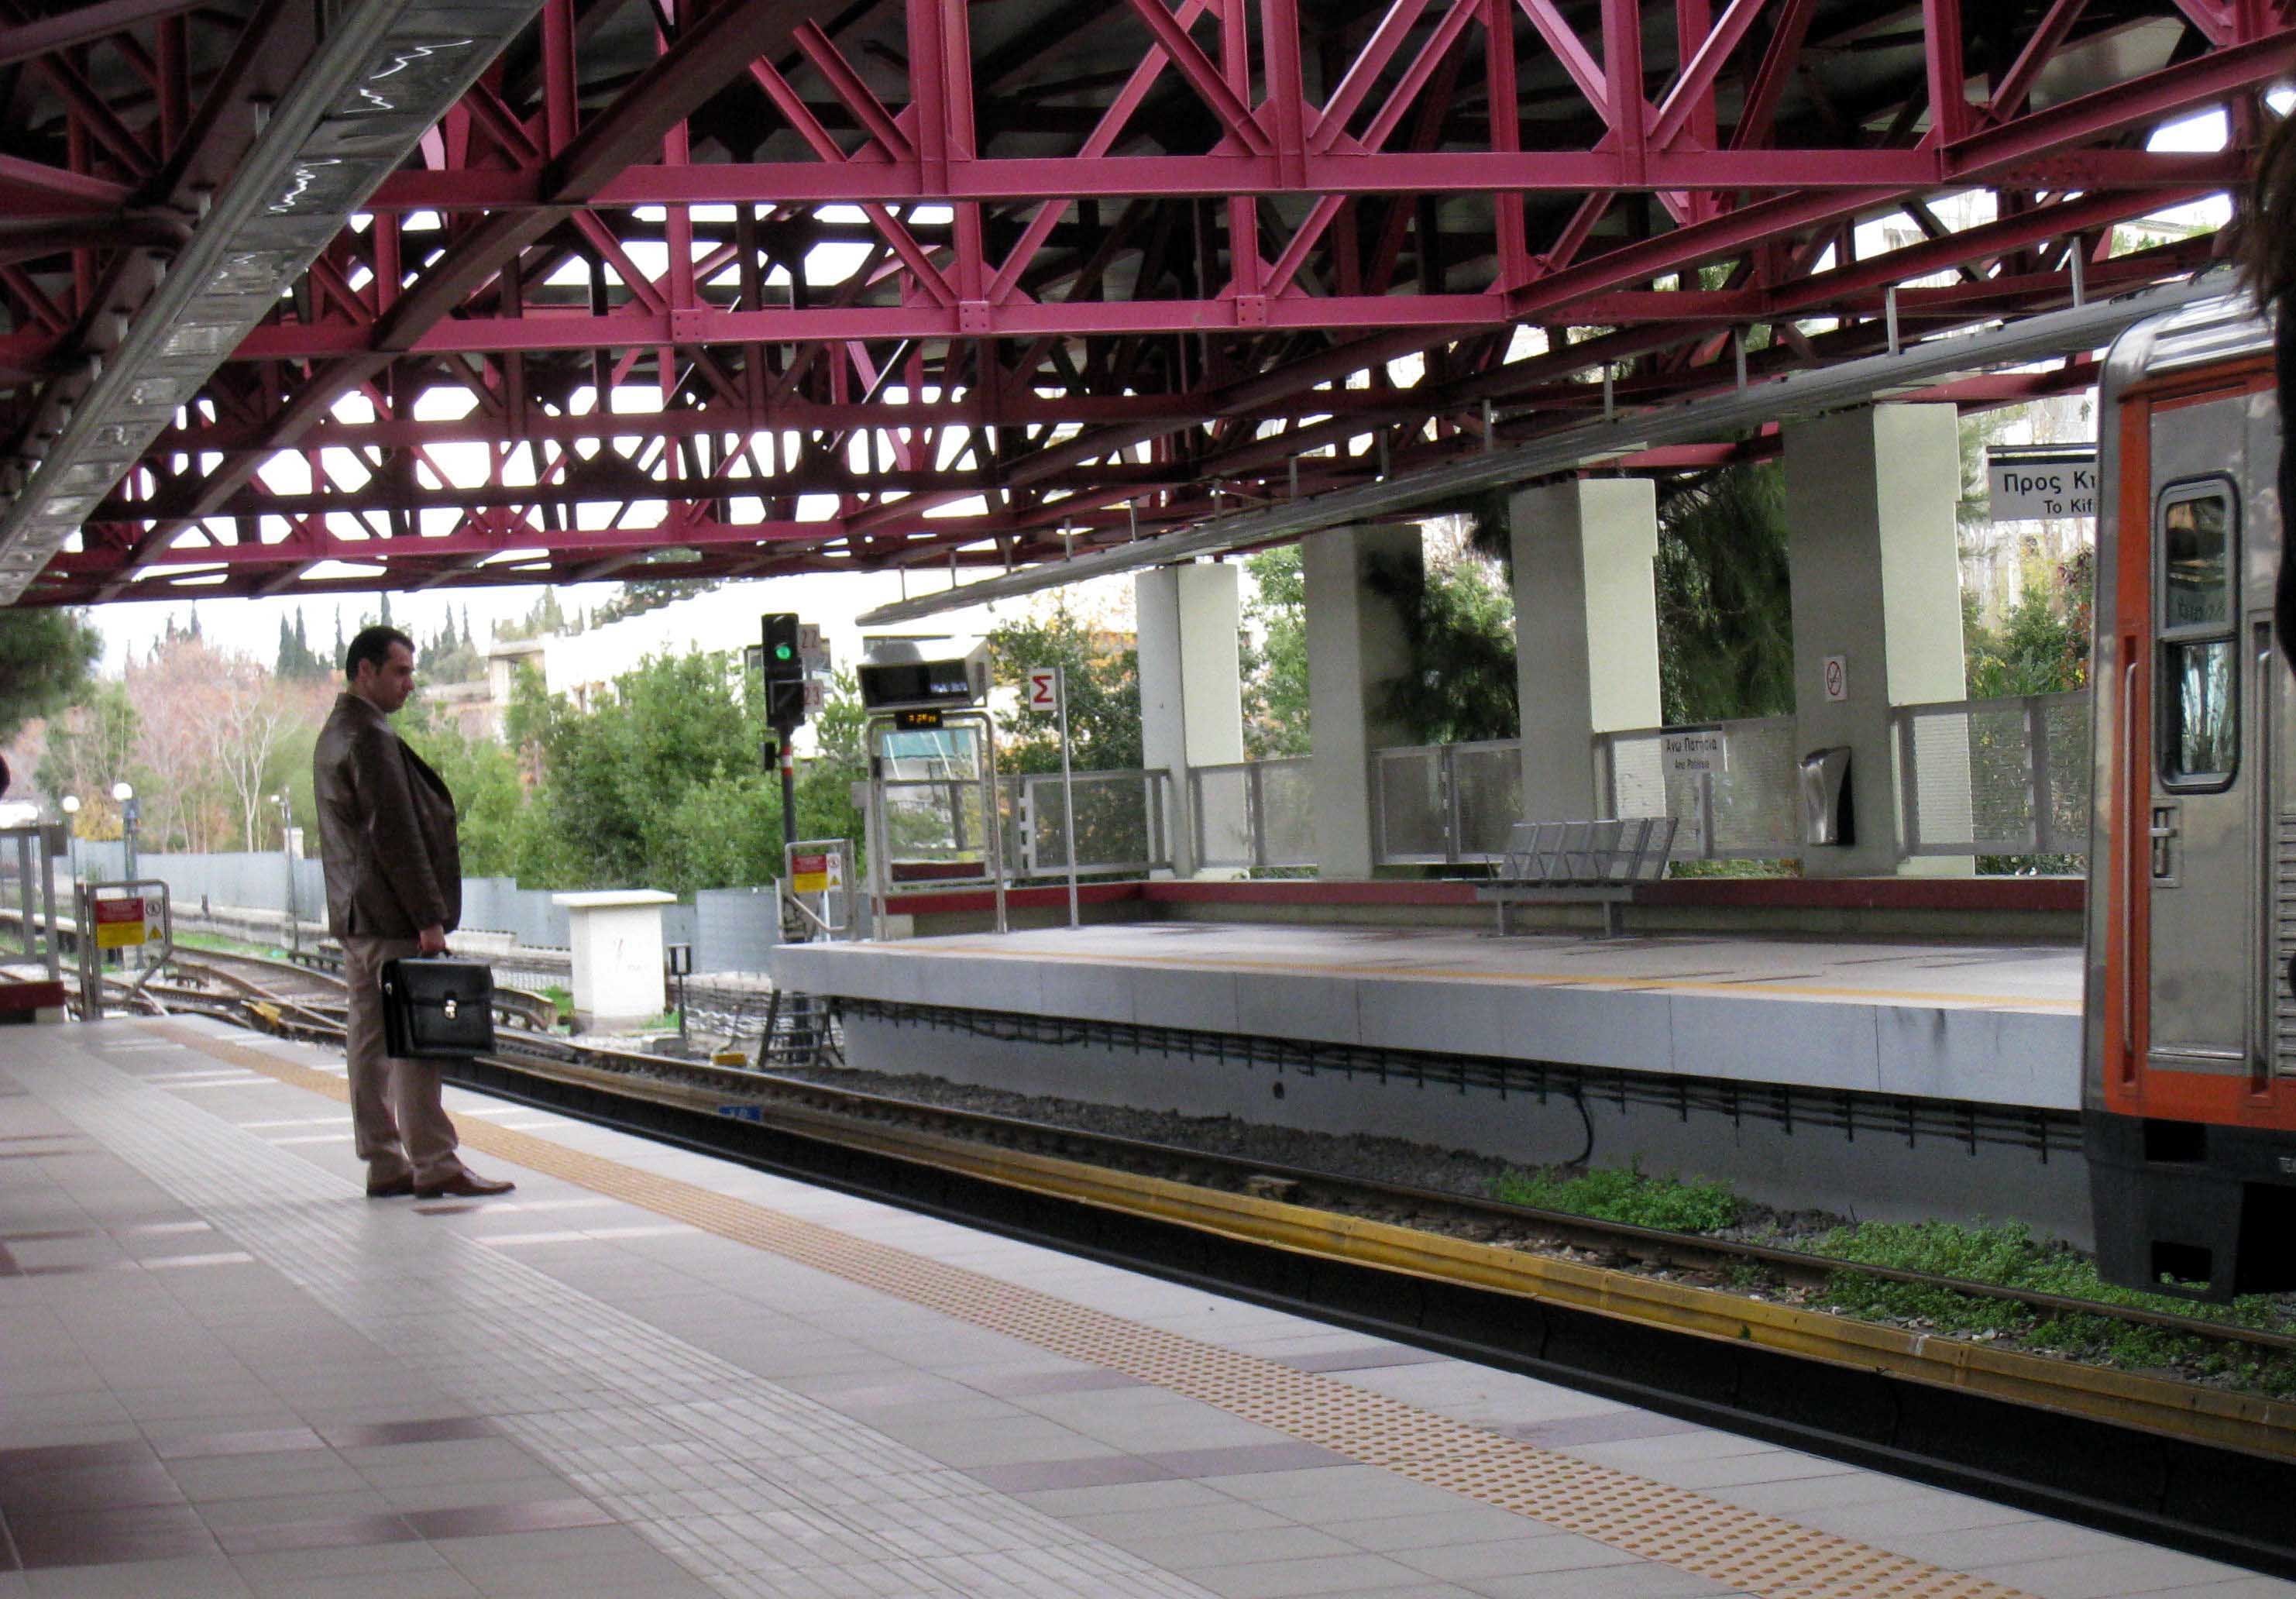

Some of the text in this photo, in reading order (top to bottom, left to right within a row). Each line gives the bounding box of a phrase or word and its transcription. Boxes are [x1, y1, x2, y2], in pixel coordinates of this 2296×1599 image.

[2004, 472, 2061, 496] Προς
[2043, 500, 2062, 514] To
[801, 629, 817, 648] 22
[1032, 675, 1053, 703] Σ
